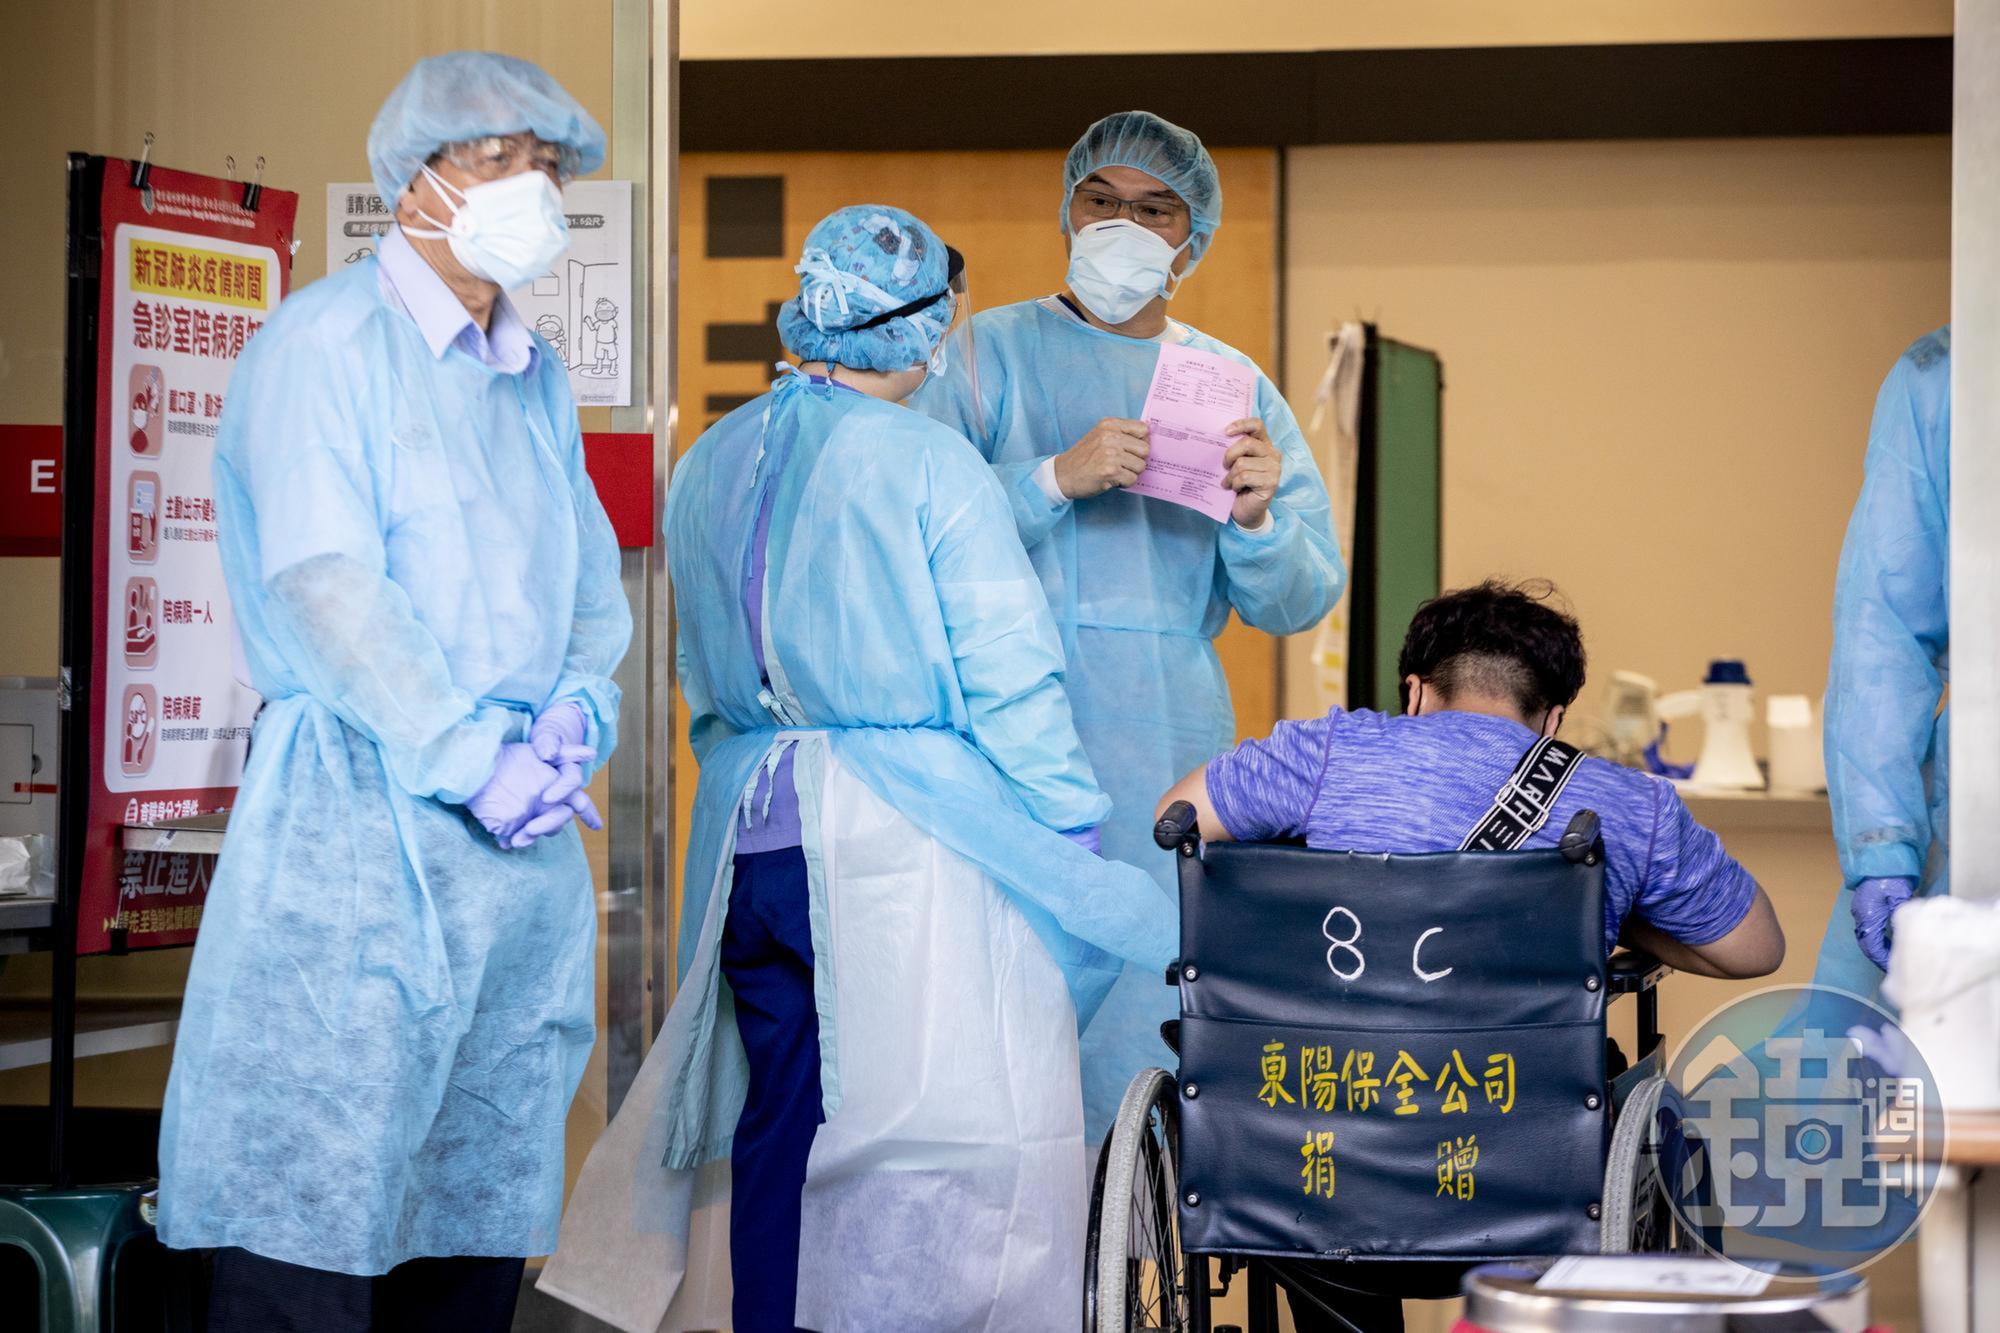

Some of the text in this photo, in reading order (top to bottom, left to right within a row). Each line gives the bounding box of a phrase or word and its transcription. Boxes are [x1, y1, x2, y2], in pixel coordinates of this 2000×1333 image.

[347, 195, 389, 214] 請保
[134, 246, 262, 302] 新冠肺炎疫情期間
[30, 459, 64, 493] E
[163, 599, 214, 624] 陪病限一人
[1322, 906, 1453, 983] 8 C
[1257, 1039, 1517, 1115] 東陽保全公司
